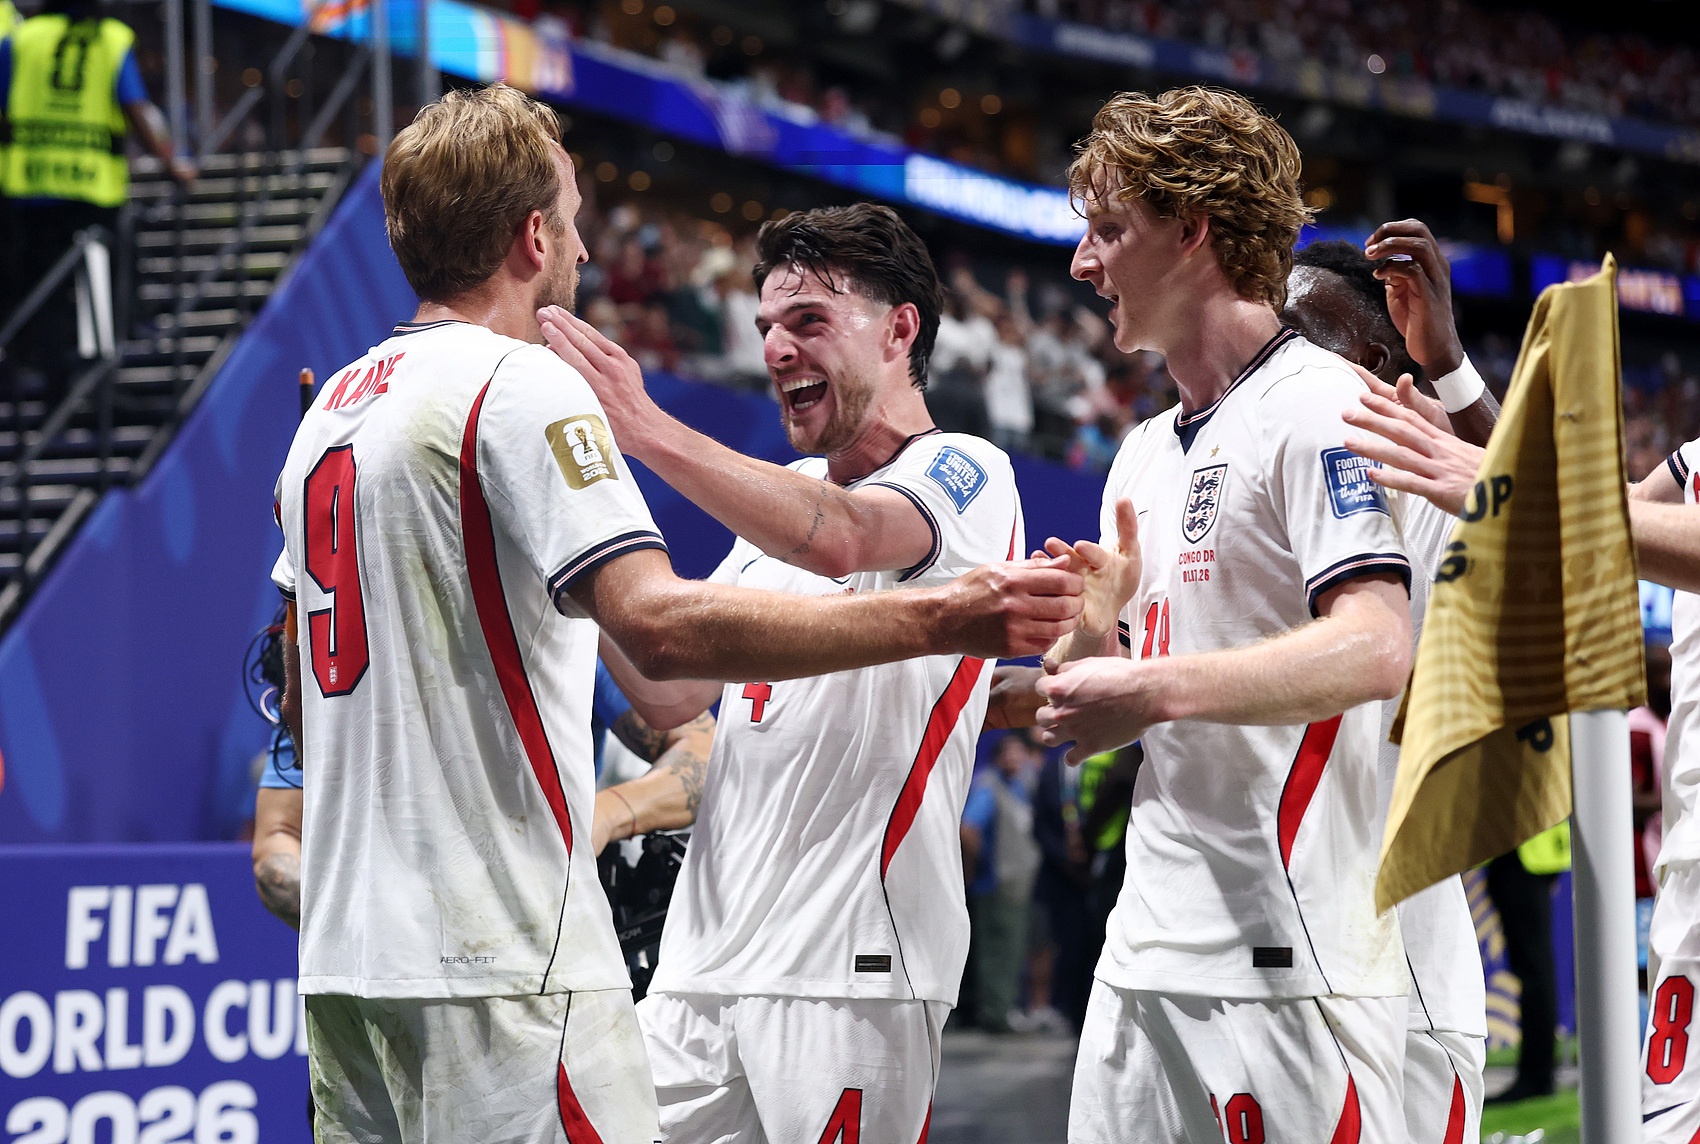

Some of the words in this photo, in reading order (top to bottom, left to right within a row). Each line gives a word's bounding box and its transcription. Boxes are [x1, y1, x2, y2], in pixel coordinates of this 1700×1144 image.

[322, 352, 406, 411] KANE
[945, 456, 977, 488] UNITES
[949, 452, 979, 480] FOOTBALL
[1337, 467, 1368, 486] UNIT
[1338, 485, 1357, 499] the
[1355, 494, 1375, 503] FIFA
[304, 442, 370, 699] 9
[1178, 550, 1201, 565] CONGO
[1203, 549, 1216, 563] DR
[65, 883, 219, 970] FIFA
[440, 956, 498, 964] AERO-FIT
[1646, 975, 1695, 1085] 8
[6, 1080, 259, 1144] 2026
